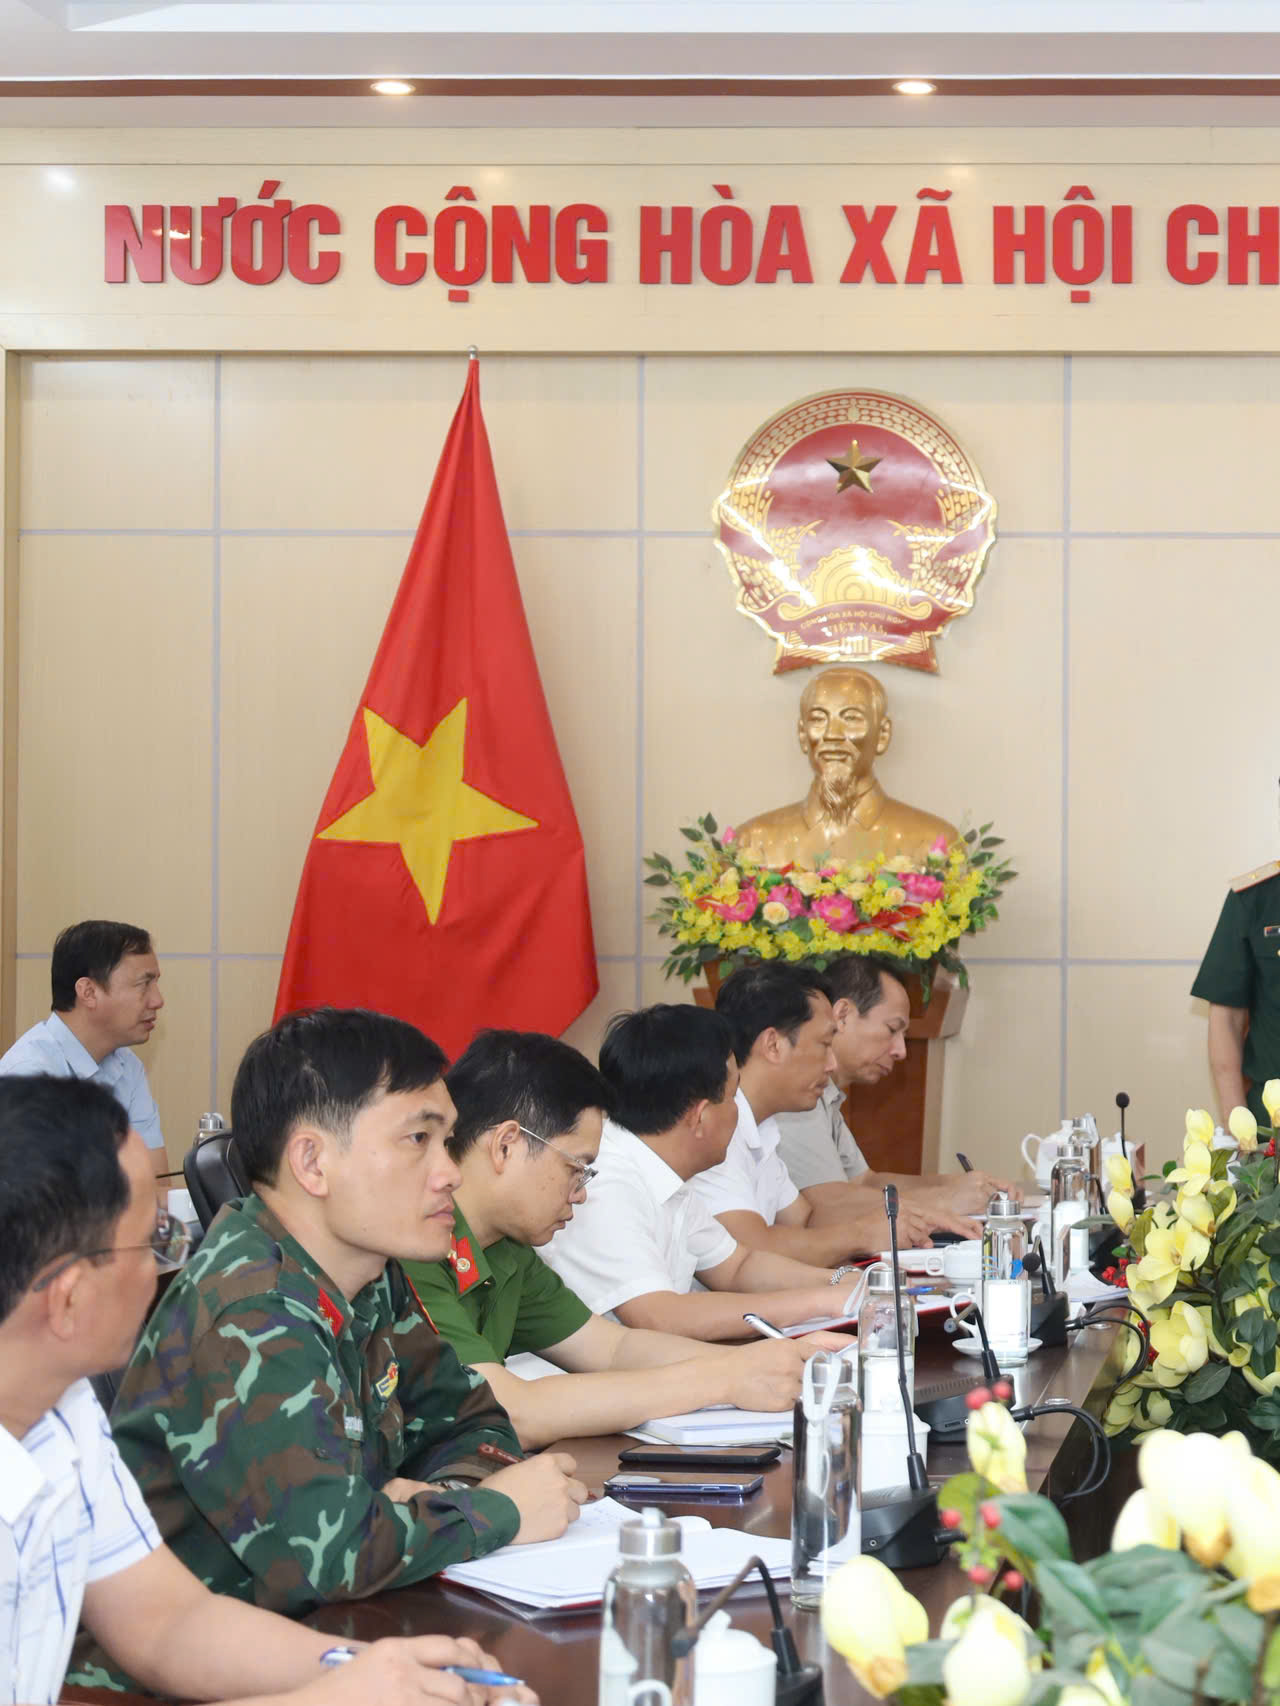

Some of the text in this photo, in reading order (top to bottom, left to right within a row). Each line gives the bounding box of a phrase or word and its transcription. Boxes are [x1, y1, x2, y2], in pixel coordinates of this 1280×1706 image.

[104, 180, 341, 285] NƯỚC
[374, 186, 608, 302] CỘNG
[639, 184, 814, 285] HÒA
[840, 187, 963, 285] XÃ
[993, 186, 1133, 303] HỘI
